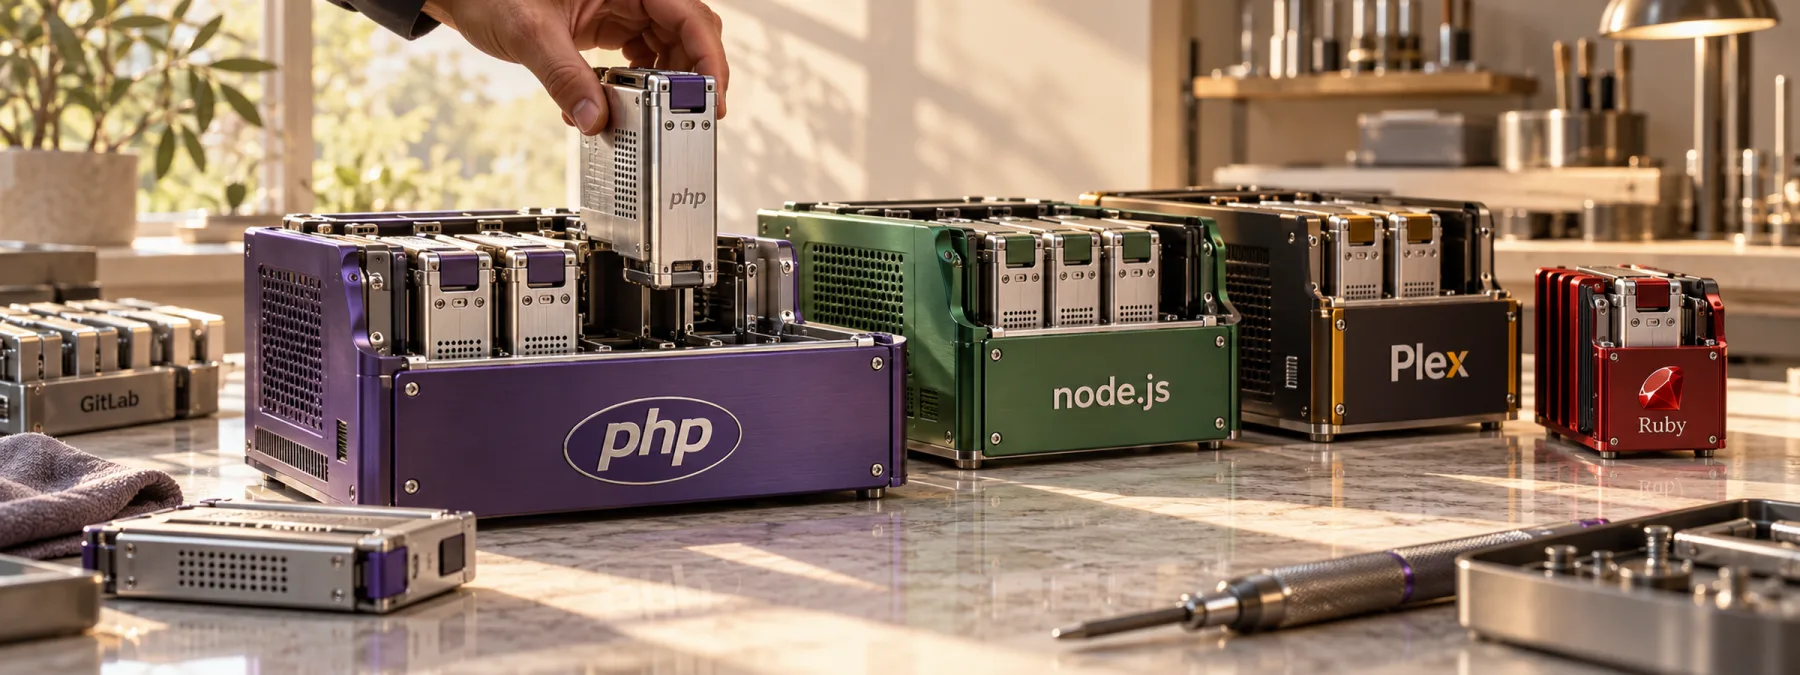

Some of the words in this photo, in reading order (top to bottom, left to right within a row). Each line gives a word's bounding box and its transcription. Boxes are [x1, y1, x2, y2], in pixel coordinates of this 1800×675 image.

[669, 187, 707, 210] php
[1390, 342, 1469, 382] Plex
[80, 389, 140, 413] GitLab
[1053, 373, 1171, 411] node.js
[597, 407, 713, 472] php
[1638, 415, 1687, 437] Ruby
